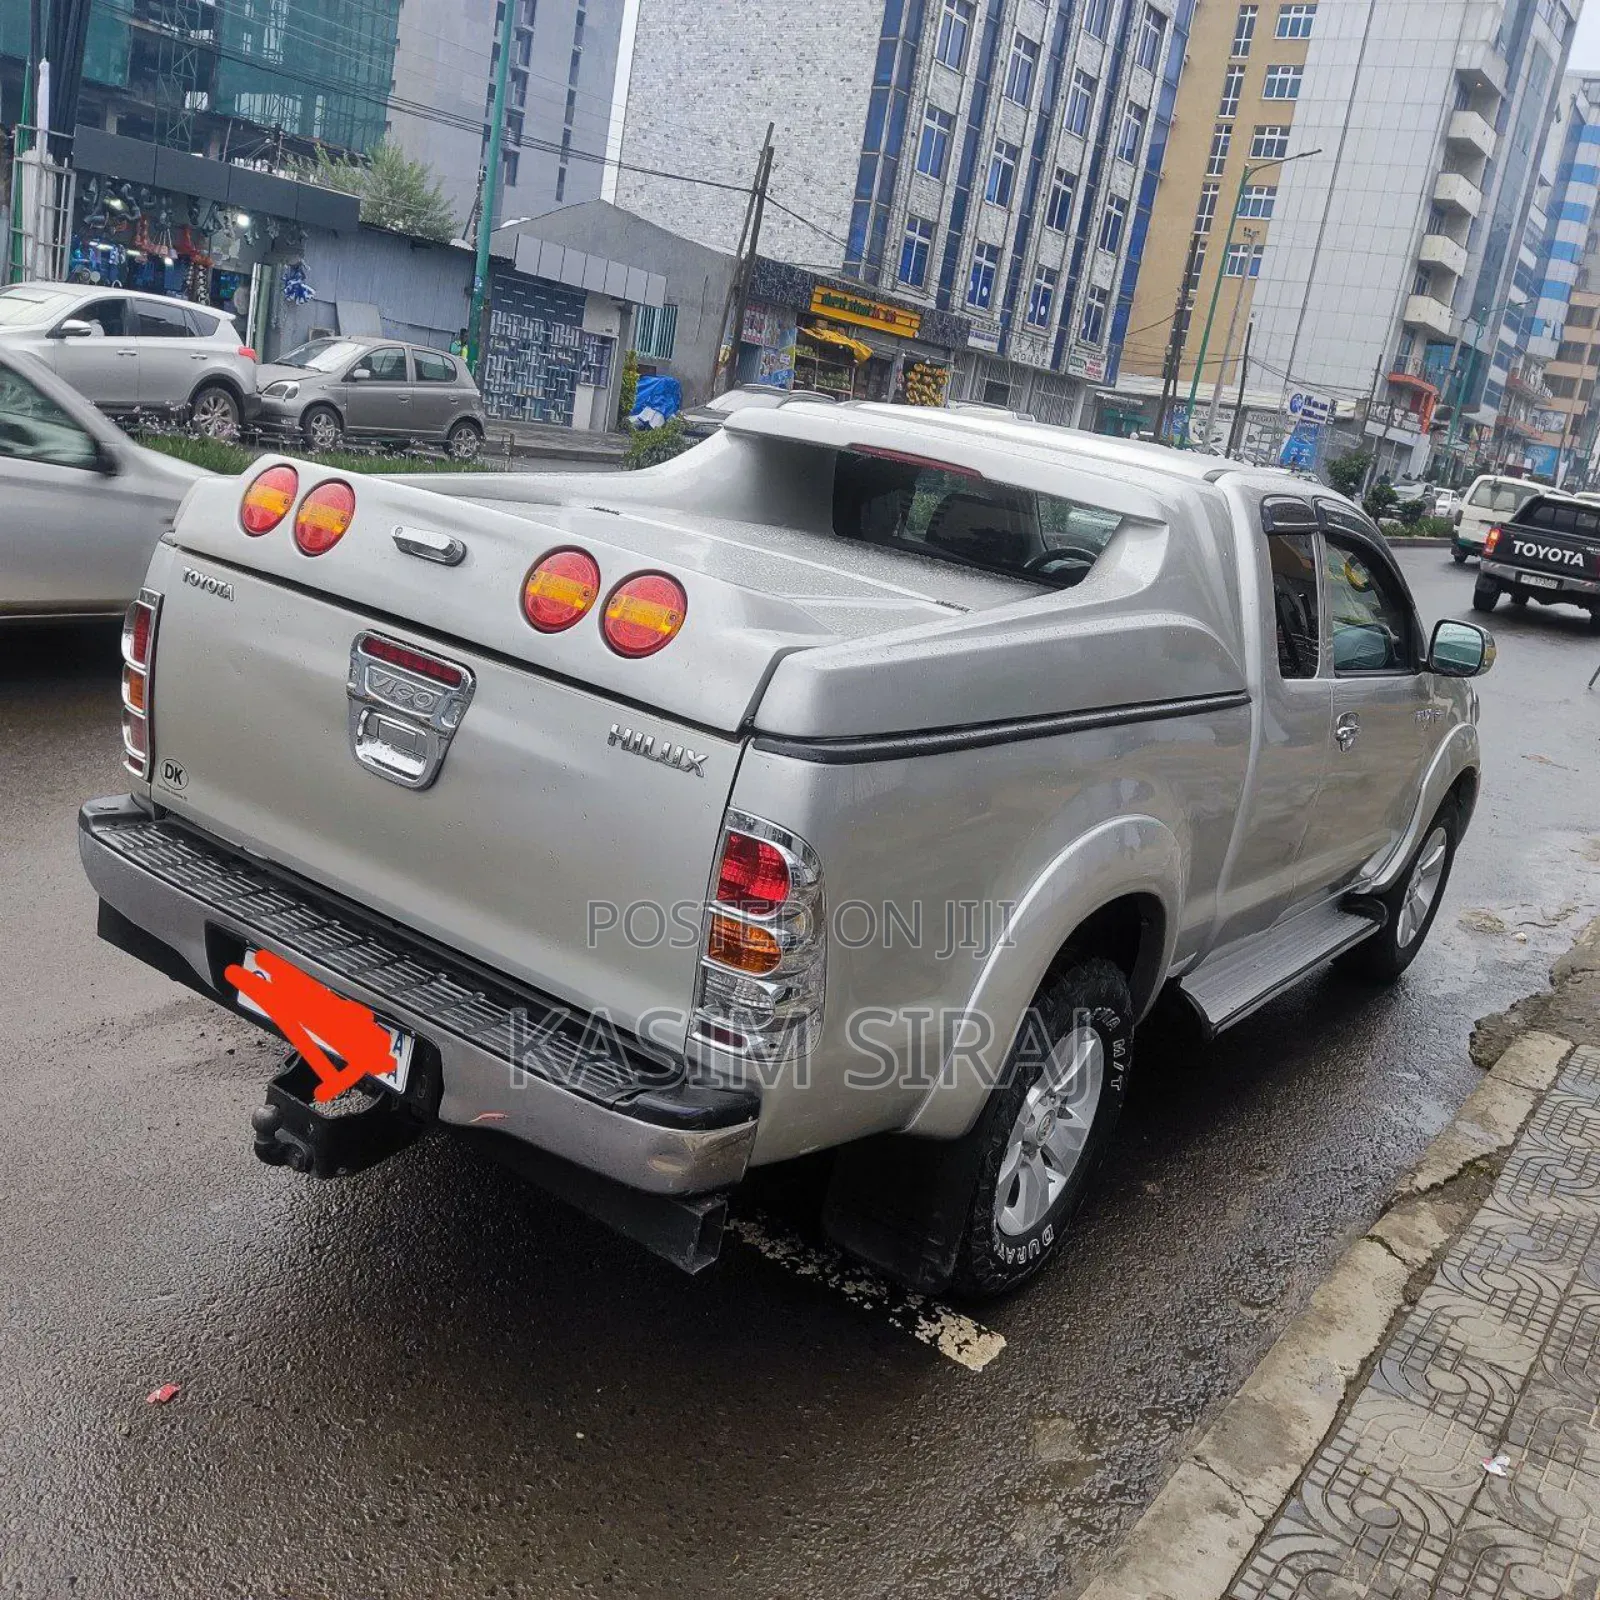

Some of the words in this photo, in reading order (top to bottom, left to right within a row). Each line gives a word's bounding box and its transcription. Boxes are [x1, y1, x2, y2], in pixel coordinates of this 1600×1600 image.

[1513, 540, 1584, 567] TOYOTA
[182, 565, 235, 601] TOYOTA
[371, 671, 434, 708] VIGO
[607, 723, 709, 778] HILUX
[165, 763, 183, 785] DK
[1111, 1038, 1126, 1091] M/T
